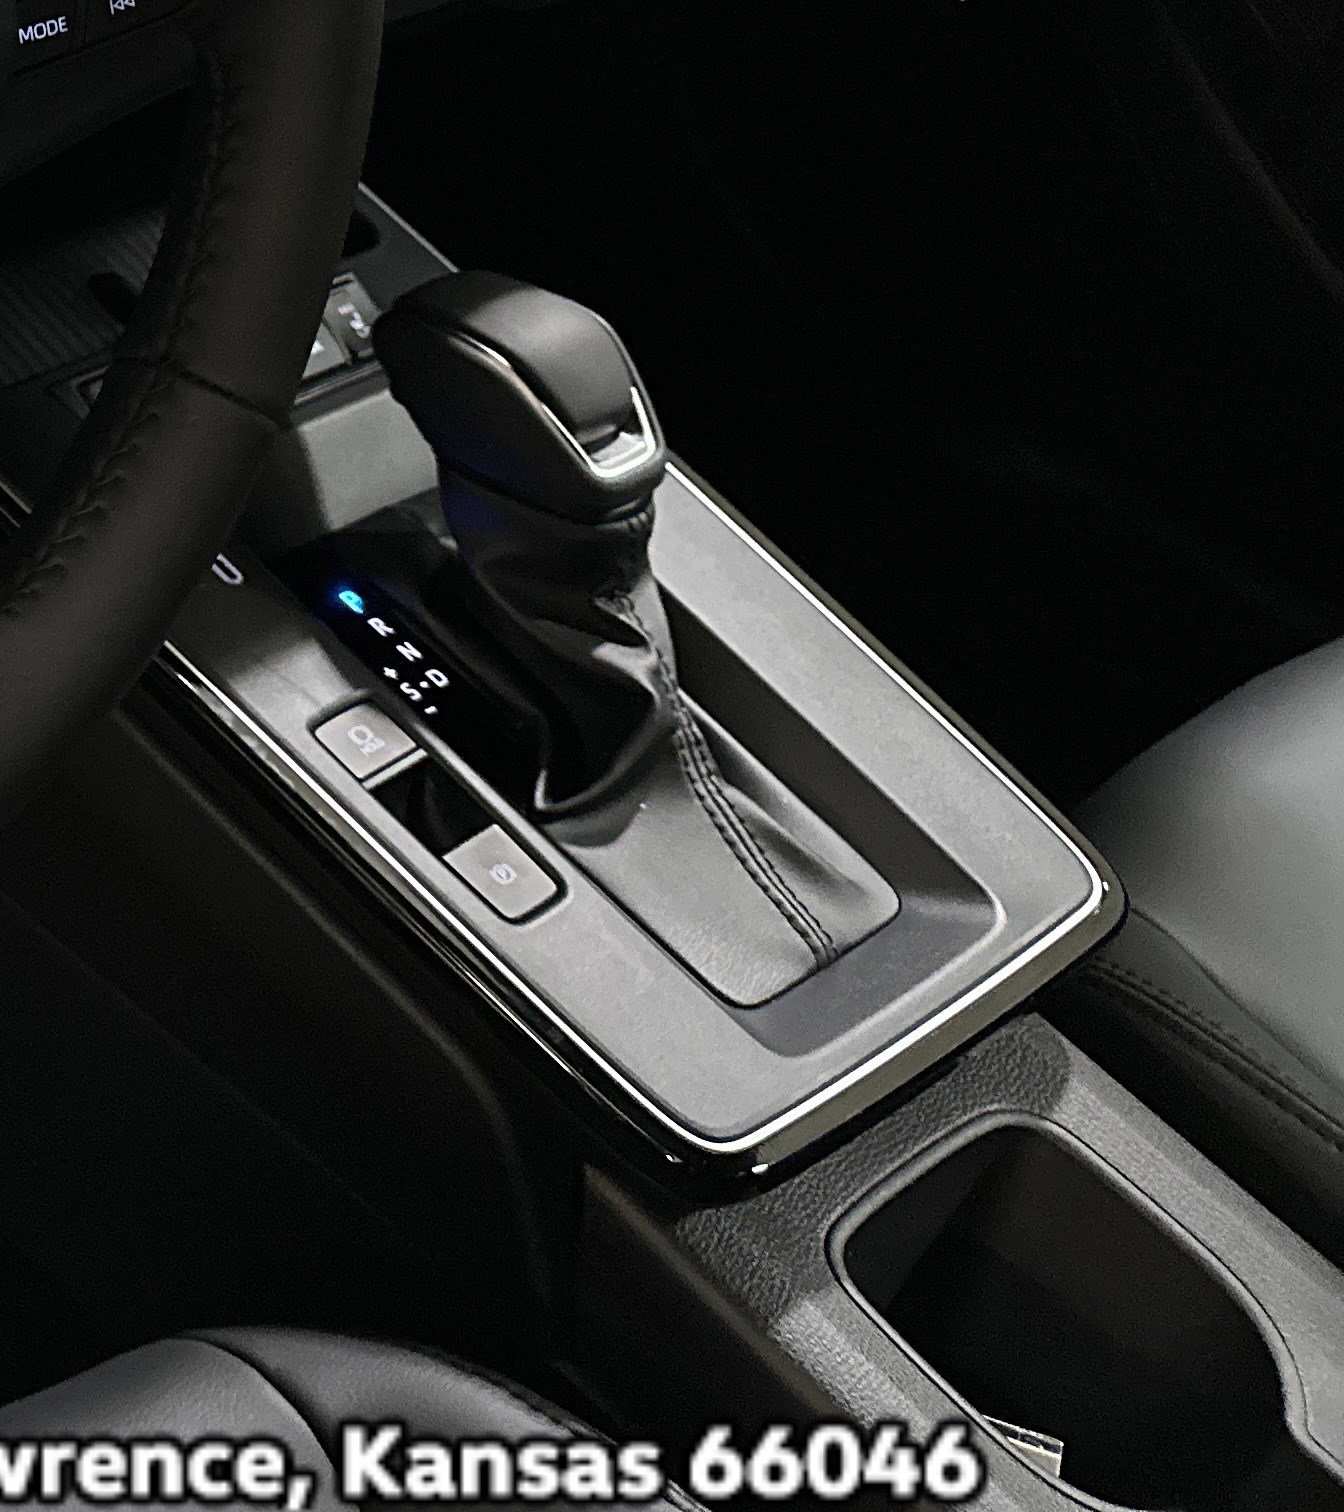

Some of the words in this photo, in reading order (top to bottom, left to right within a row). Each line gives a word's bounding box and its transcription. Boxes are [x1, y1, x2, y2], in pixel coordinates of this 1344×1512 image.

[18, 15, 69, 45] MODE
[337, 588, 365, 615] P
[366, 615, 396, 638] R
[396, 640, 423, 662] N
[424, 667, 451, 688] D
